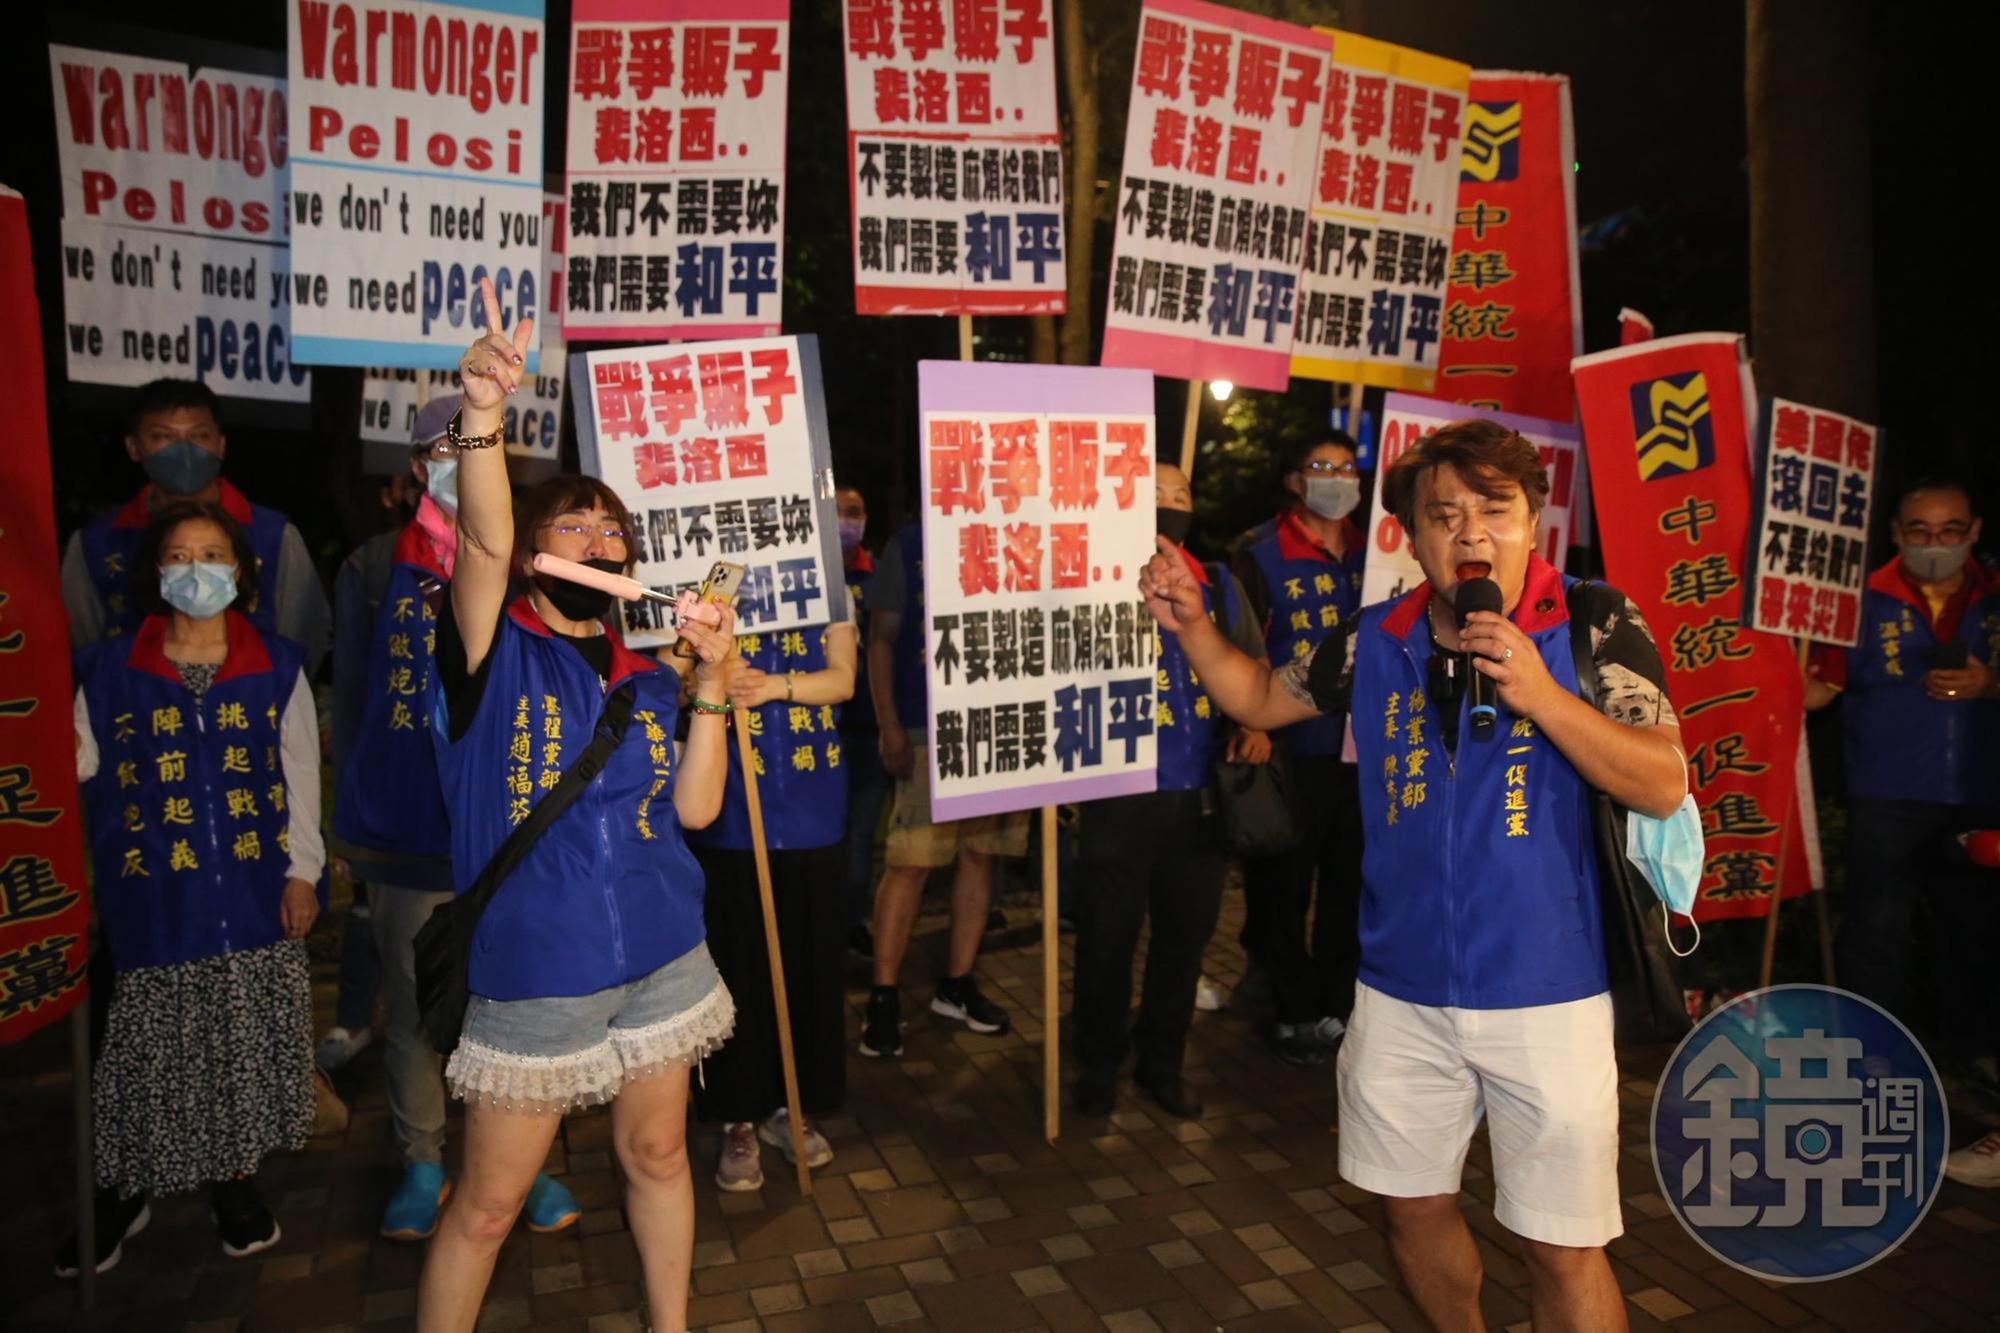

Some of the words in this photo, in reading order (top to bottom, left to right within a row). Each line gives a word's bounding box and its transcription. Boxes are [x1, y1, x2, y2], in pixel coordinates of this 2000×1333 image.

[574, 27, 781, 101] 戰爭販子
[849, 0, 1048, 64] 戰爭販子
[1137, 16, 1323, 128] 戰爭販子
[62, 63, 288, 178] warmonge
[309, 106, 522, 174] Pelosi
[294, 190, 322, 227] we
[430, 197, 485, 241] need
[499, 211, 539, 249] you
[571, 178, 779, 237] 我們不需要妳
[65, 246, 95, 281] we
[202, 258, 257, 299] need
[568, 242, 777, 318] 我們需要和平
[859, 211, 1062, 284] 我們需要和平
[295, 273, 328, 307] we
[349, 271, 417, 314] need
[422, 260, 536, 336] peace
[1114, 256, 1296, 344] 我們需要和平
[1444, 200, 1517, 412] 中華統一
[69, 323, 103, 354] we
[122, 325, 190, 364] need
[364, 400, 390, 429] we
[504, 405, 557, 449] ace
[535, 374, 559, 399] us
[594, 348, 797, 442] 戰爭販子
[633, 433, 769, 490] 裴洛西
[929, 418, 1151, 516] 戰爭販子
[1772, 454, 1867, 529] 滾回去
[625, 557, 821, 632] 我們和平
[933, 600, 1155, 686] 不要製造麻煩給我們
[781, 632, 816, 772] 挑戰禍
[936, 677, 1155, 781] 我們需要和平
[1659, 496, 1780, 901] 中華統一促進黨
[151, 705, 199, 872] 陣前起義
[216, 702, 261, 861] 挑起戰禍
